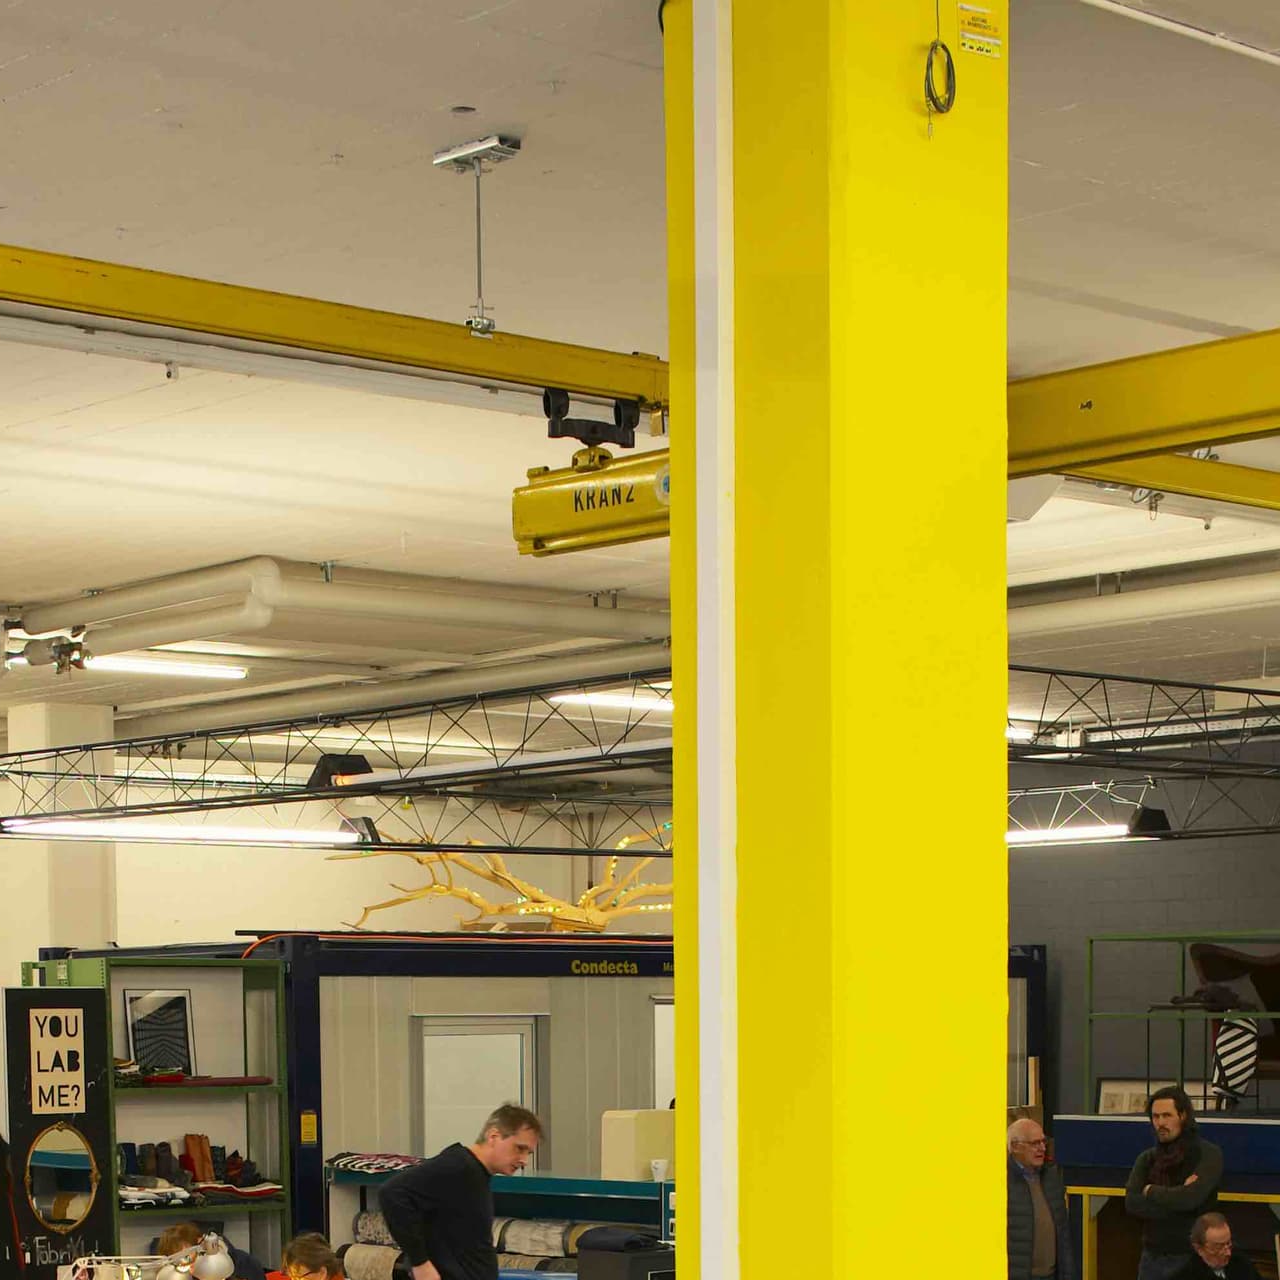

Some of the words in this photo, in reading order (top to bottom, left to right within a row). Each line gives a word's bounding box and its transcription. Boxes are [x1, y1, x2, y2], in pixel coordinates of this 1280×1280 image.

[571, 959, 639, 974] Condecta
[35, 1015, 78, 1038] YOU
[37, 1050, 81, 1073] LAB
[38, 1084, 81, 1108] ME?
